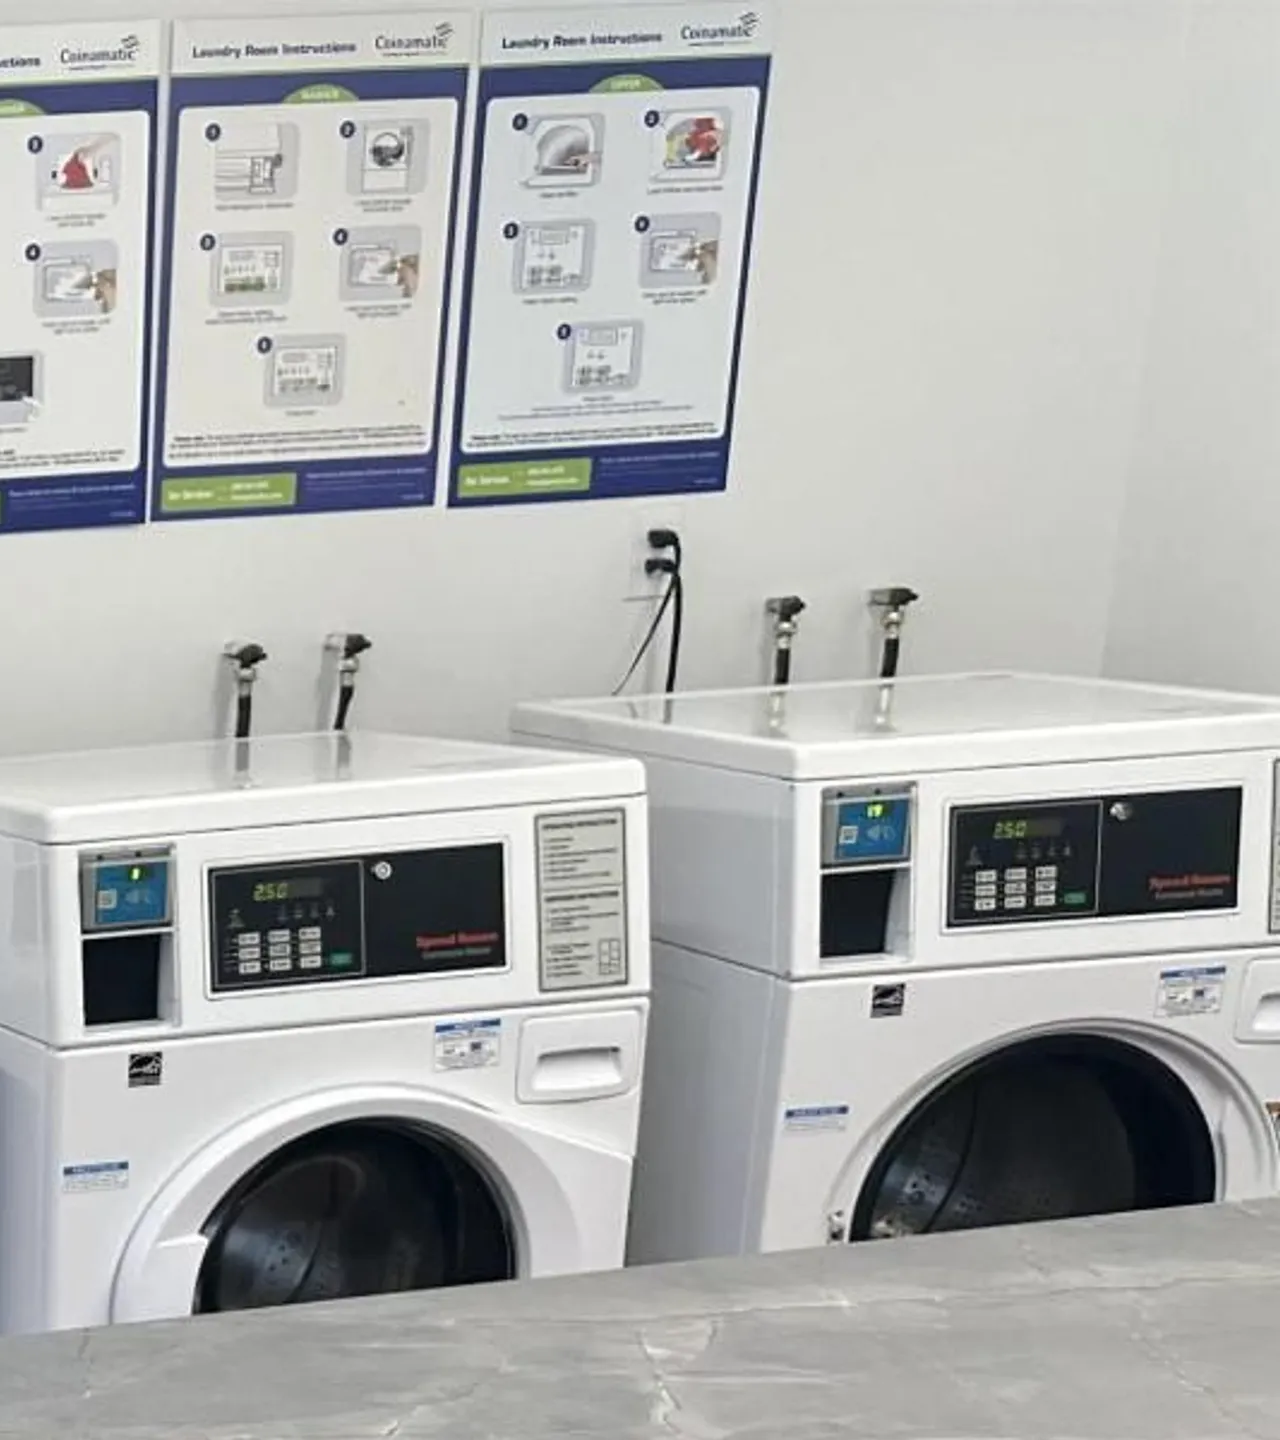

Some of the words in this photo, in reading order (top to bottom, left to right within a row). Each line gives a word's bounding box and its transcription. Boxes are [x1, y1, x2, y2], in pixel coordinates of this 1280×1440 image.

[502, 35, 550, 51] Laundry
[553, 34, 587, 47] Room
[590, 31, 662, 45] Instructions
[680, 25, 752, 41] Coinamatic
[193, 45, 241, 59] Laundry
[245, 44, 279, 57] Room
[282, 42, 357, 55] Instructions
[375, 35, 447, 50] Coinamatic
[60, 48, 136, 65] Coinamatic
